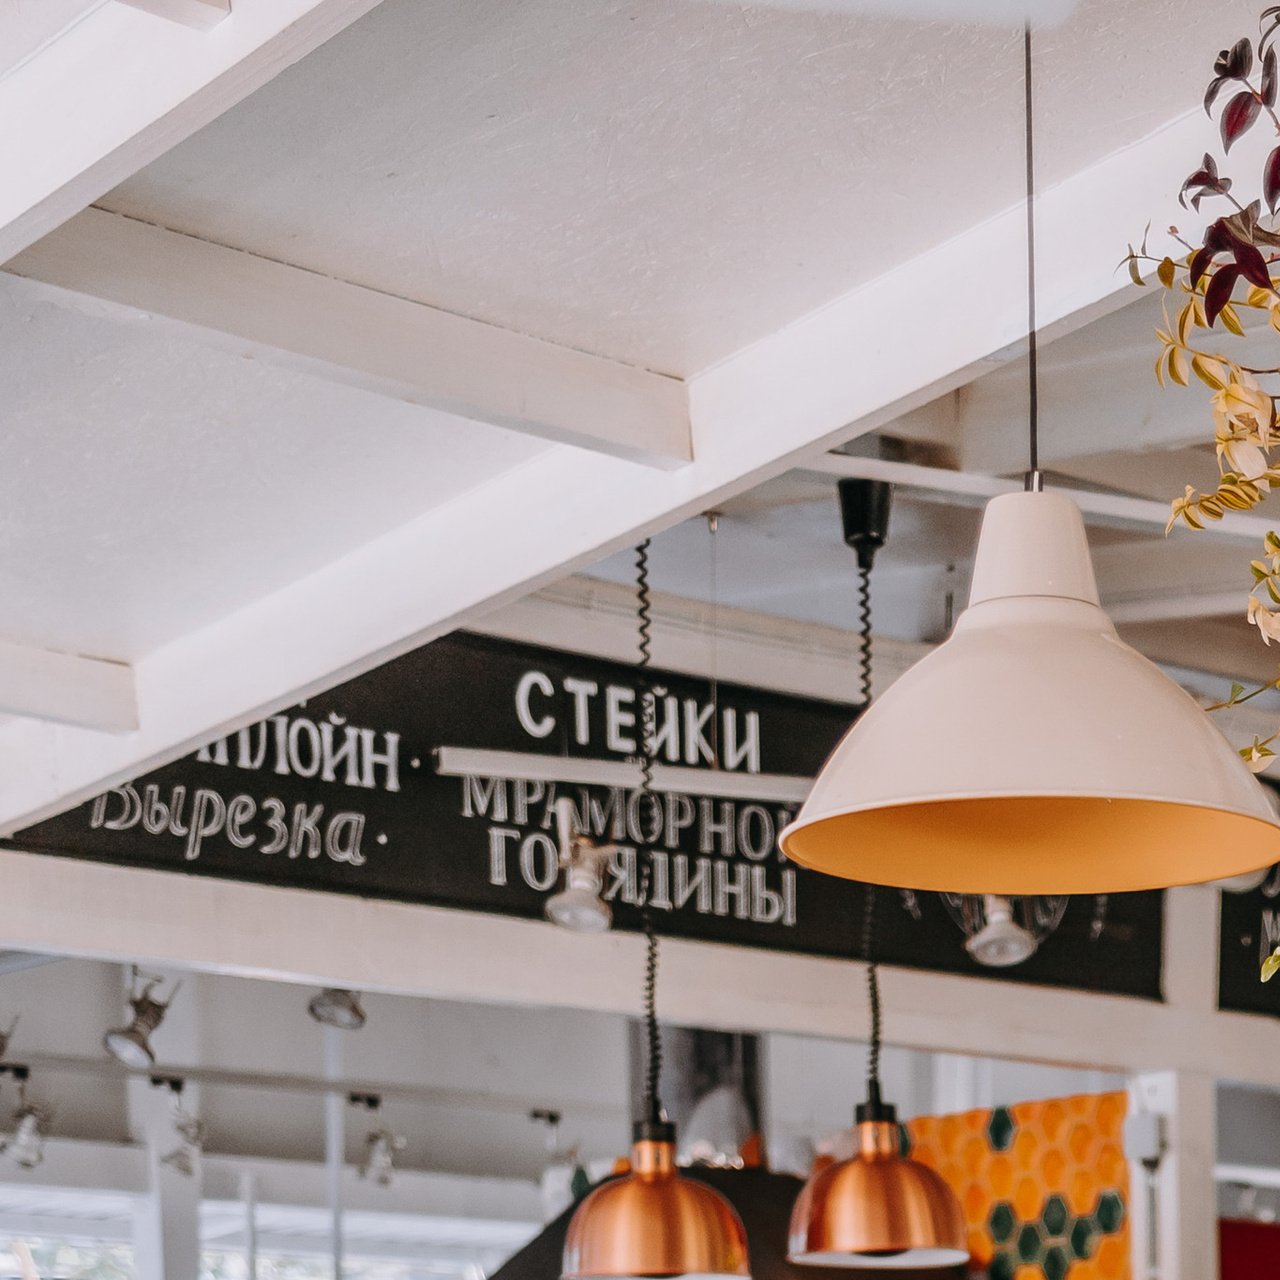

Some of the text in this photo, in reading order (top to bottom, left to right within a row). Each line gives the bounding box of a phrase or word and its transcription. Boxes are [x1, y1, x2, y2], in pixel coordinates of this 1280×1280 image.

[514, 670, 761, 774] СТЕЙКИ
[90, 782, 366, 866] Вырезка
[460, 774, 798, 864] МРАМОРНО
[488, 825, 797, 927] ГОЯДИНЫ
